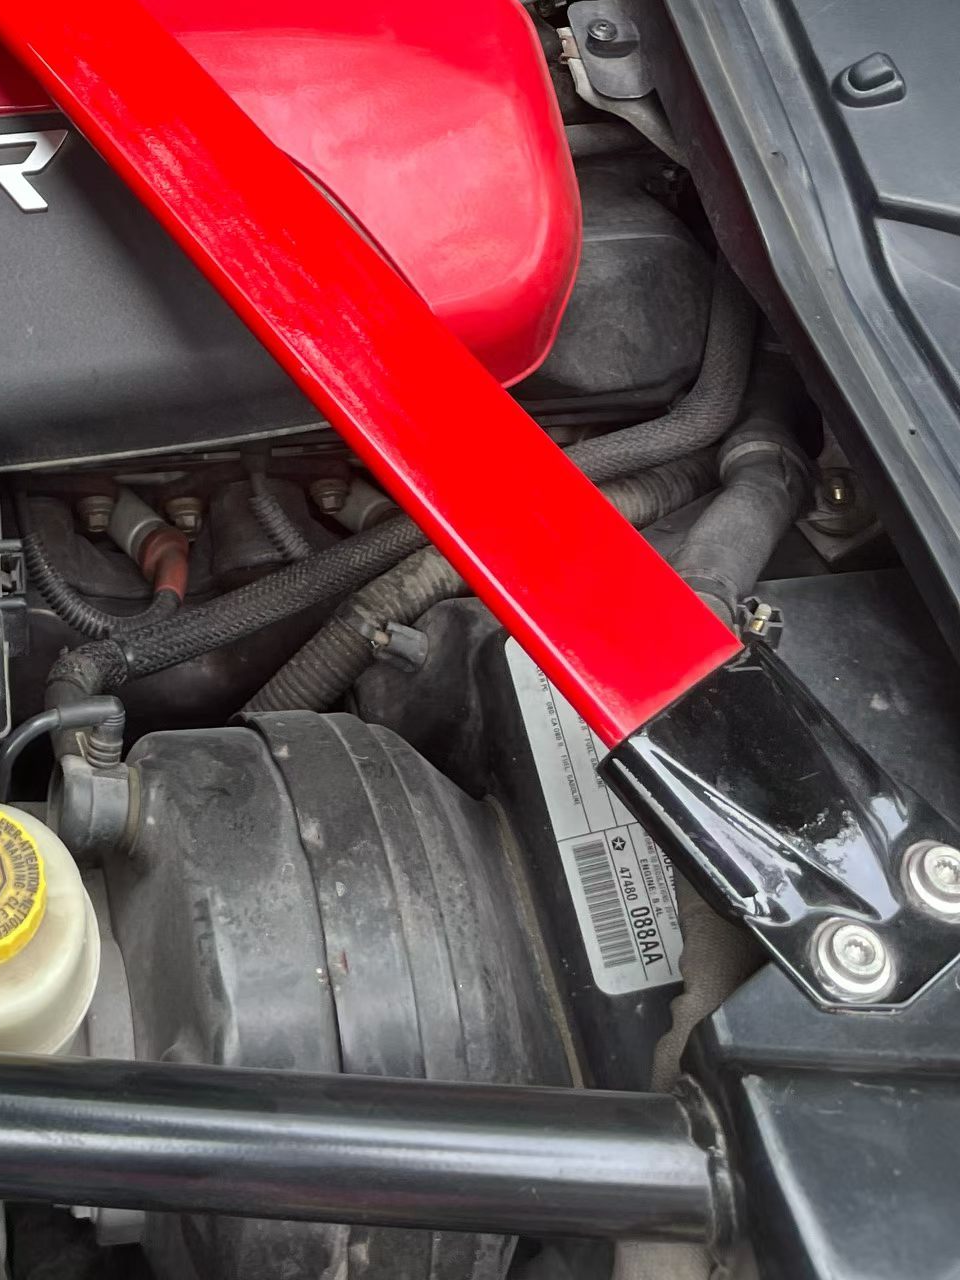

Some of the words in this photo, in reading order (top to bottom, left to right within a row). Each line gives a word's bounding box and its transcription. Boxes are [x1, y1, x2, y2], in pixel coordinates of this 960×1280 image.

[640, 858, 657, 896] ENGINE:
[618, 865, 638, 902] 47480
[629, 904, 665, 966] 088AA
